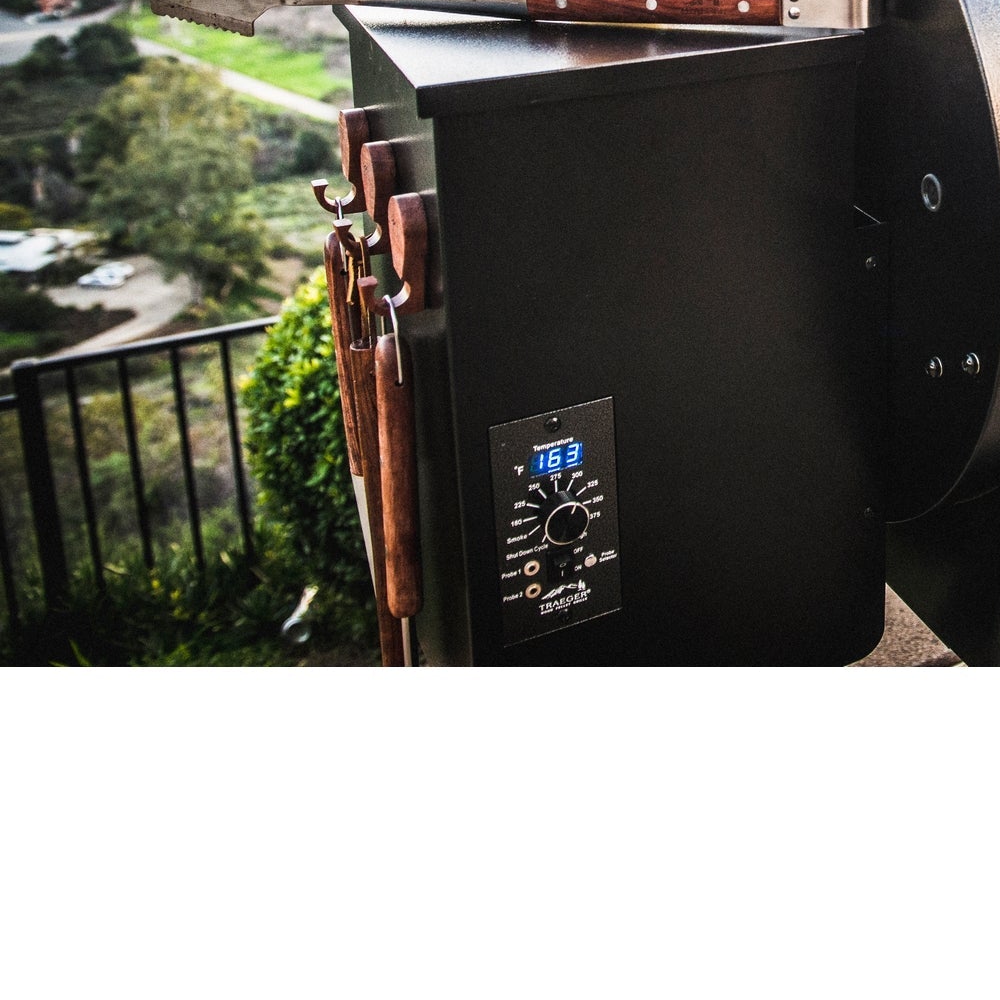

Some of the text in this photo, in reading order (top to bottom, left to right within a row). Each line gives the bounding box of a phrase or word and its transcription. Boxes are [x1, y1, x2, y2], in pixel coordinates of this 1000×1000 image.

[532, 437, 574, 452] Temperature
[539, 442, 580, 469] 163
[550, 473, 562, 481] 275
[571, 470, 583, 479] 300
[528, 483, 540, 491] 250
[587, 479, 599, 488] 325
[592, 495, 604, 504] 350
[513, 500, 526, 509] 225
[590, 511, 601, 520] 375
[506, 534, 528, 545] Smoke
[505, 543, 549, 561] Shut Down Cycle
[501, 571, 518, 580] Probe
[503, 594, 519, 603] Probe
[538, 590, 588, 612] TRAEGER
